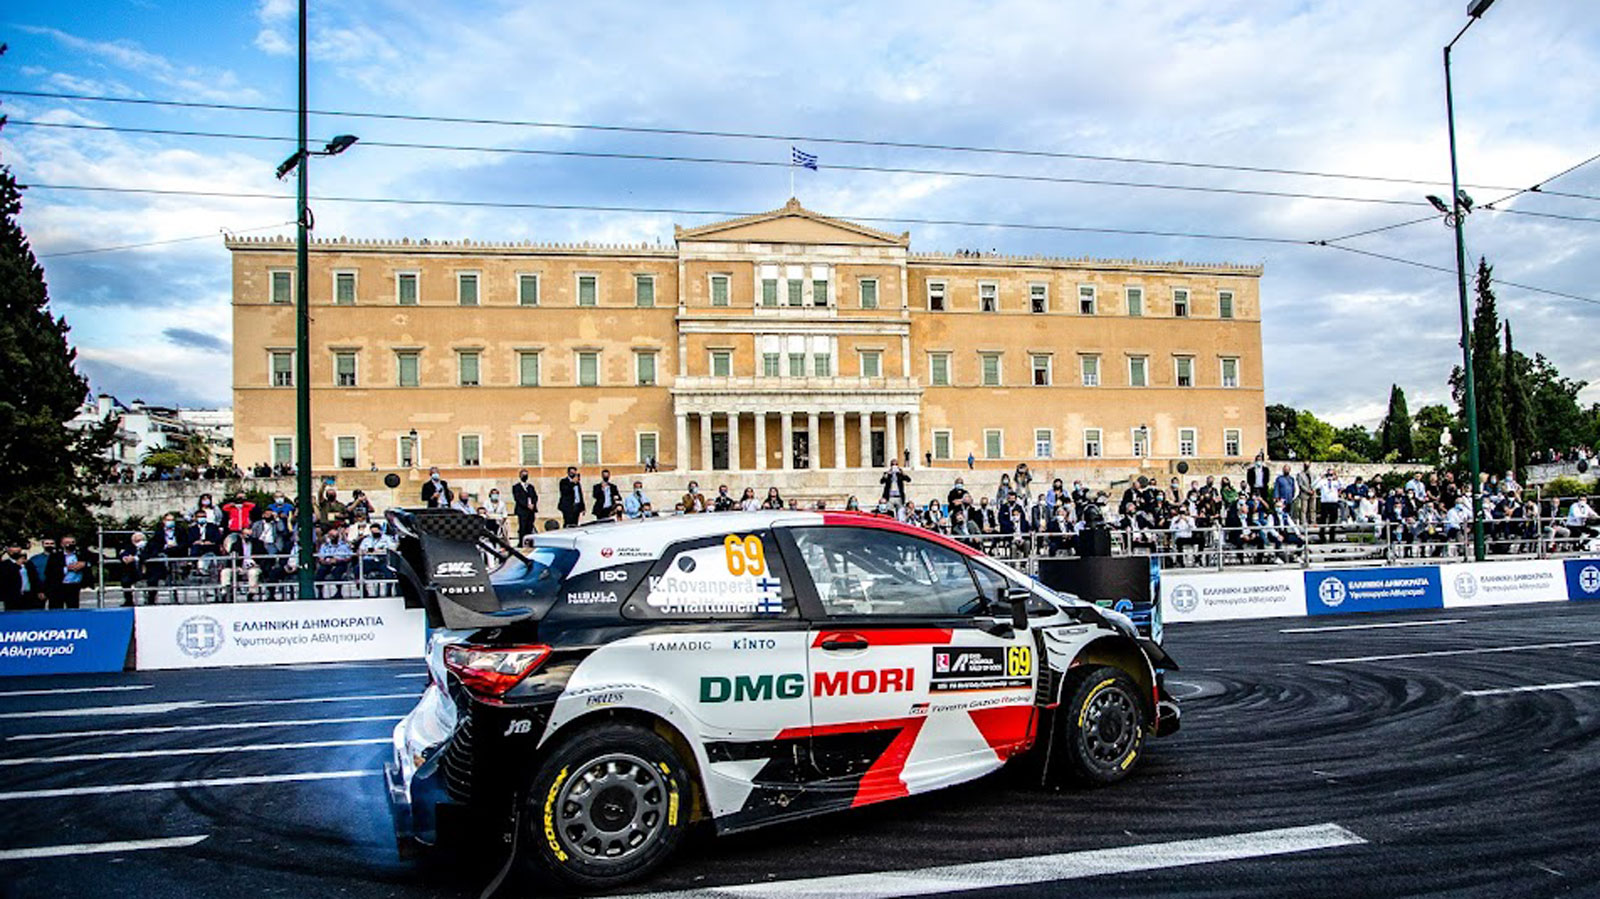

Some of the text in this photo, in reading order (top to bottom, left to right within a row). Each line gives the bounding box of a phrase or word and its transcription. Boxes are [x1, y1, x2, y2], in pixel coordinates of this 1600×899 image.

[724, 534, 765, 576] 69
[233, 616, 384, 632] ΕΛΛΗΝΙΚΗ ΔΗΜΟΚΡΑΤΙΑ
[650, 641, 712, 651] TAMADIC
[1008, 646, 1032, 676] 69
[699, 667, 914, 703] DMG MORI
